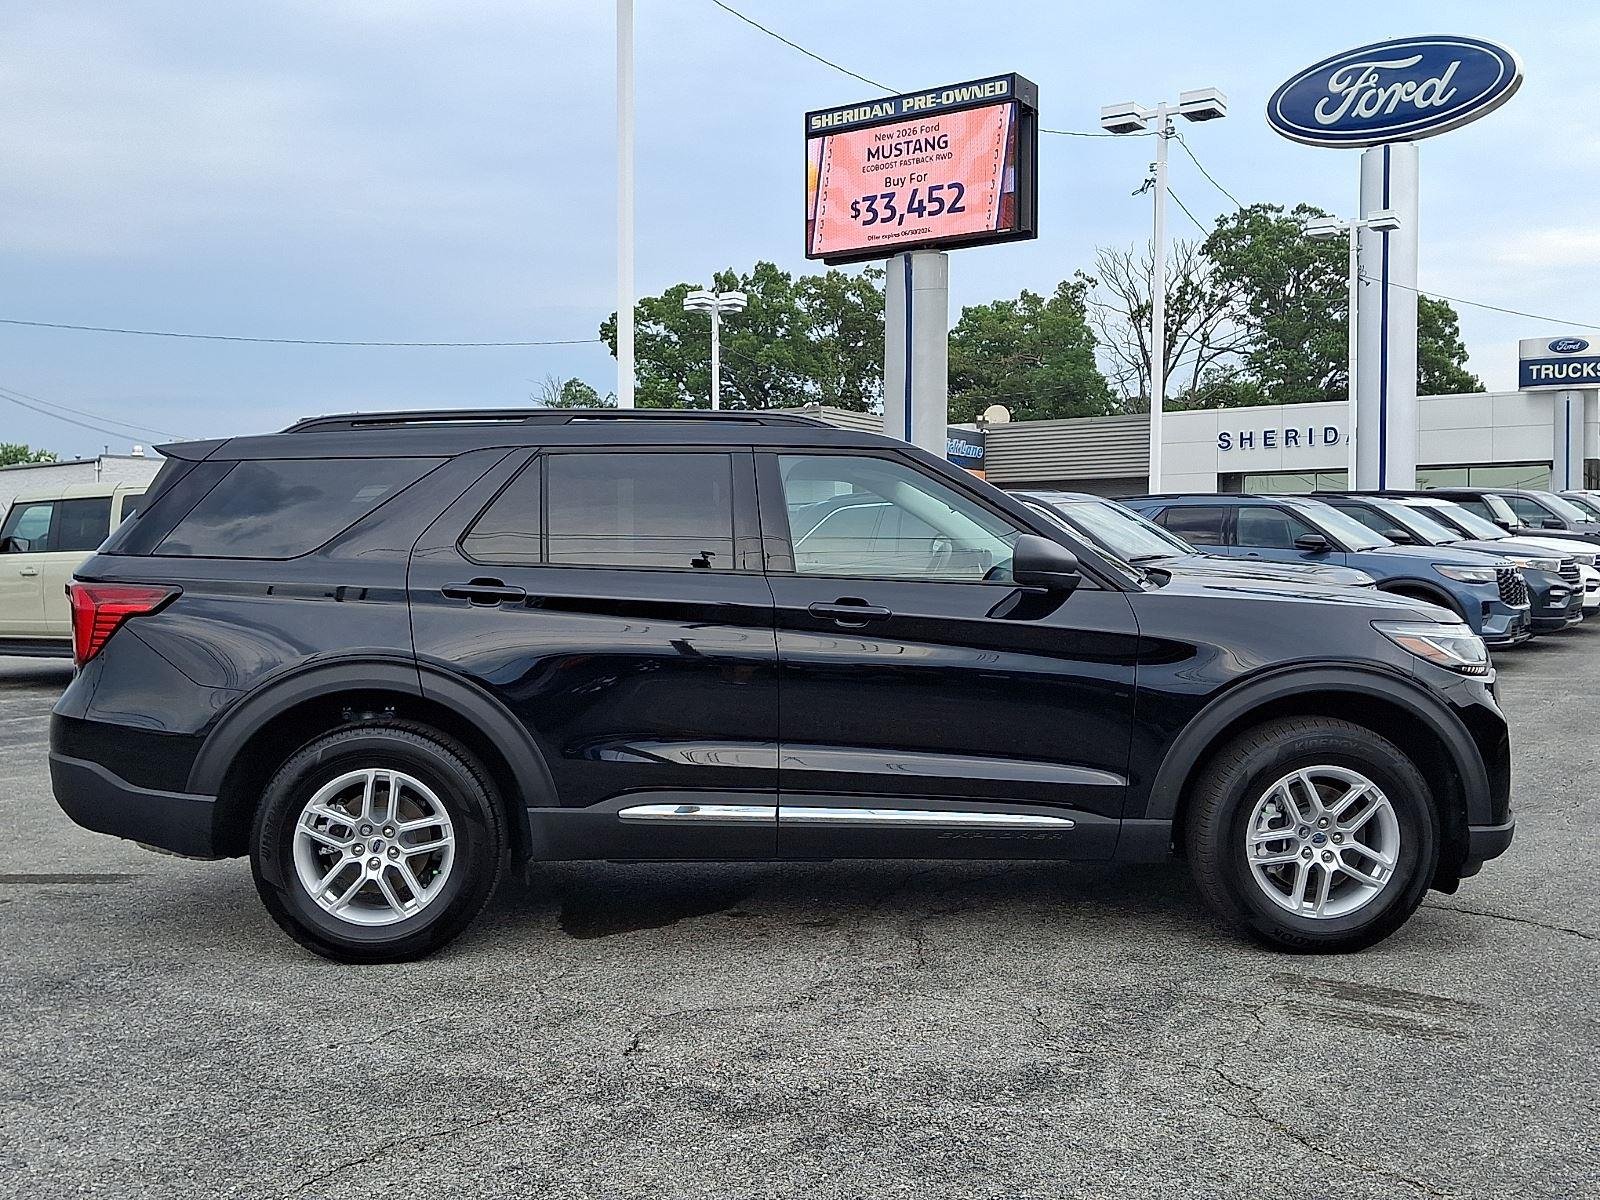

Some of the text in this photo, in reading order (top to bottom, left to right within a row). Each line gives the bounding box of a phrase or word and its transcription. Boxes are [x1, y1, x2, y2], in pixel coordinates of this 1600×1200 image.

[1314, 54, 1462, 125] Ford
[811, 80, 1008, 129] SHERIDAN PRE-OWNED
[874, 122, 940, 142] New 2026 Ford
[867, 134, 949, 162] MUSTANG
[862, 151, 953, 173] ECOBOOST FASTBACK RWD
[884, 172, 928, 188] Buy For
[850, 182, 966, 226] $33,452
[1556, 340, 1581, 351] Ford
[1217, 426, 1349, 450] SHERID
[938, 832, 1063, 840] EXPLORER
